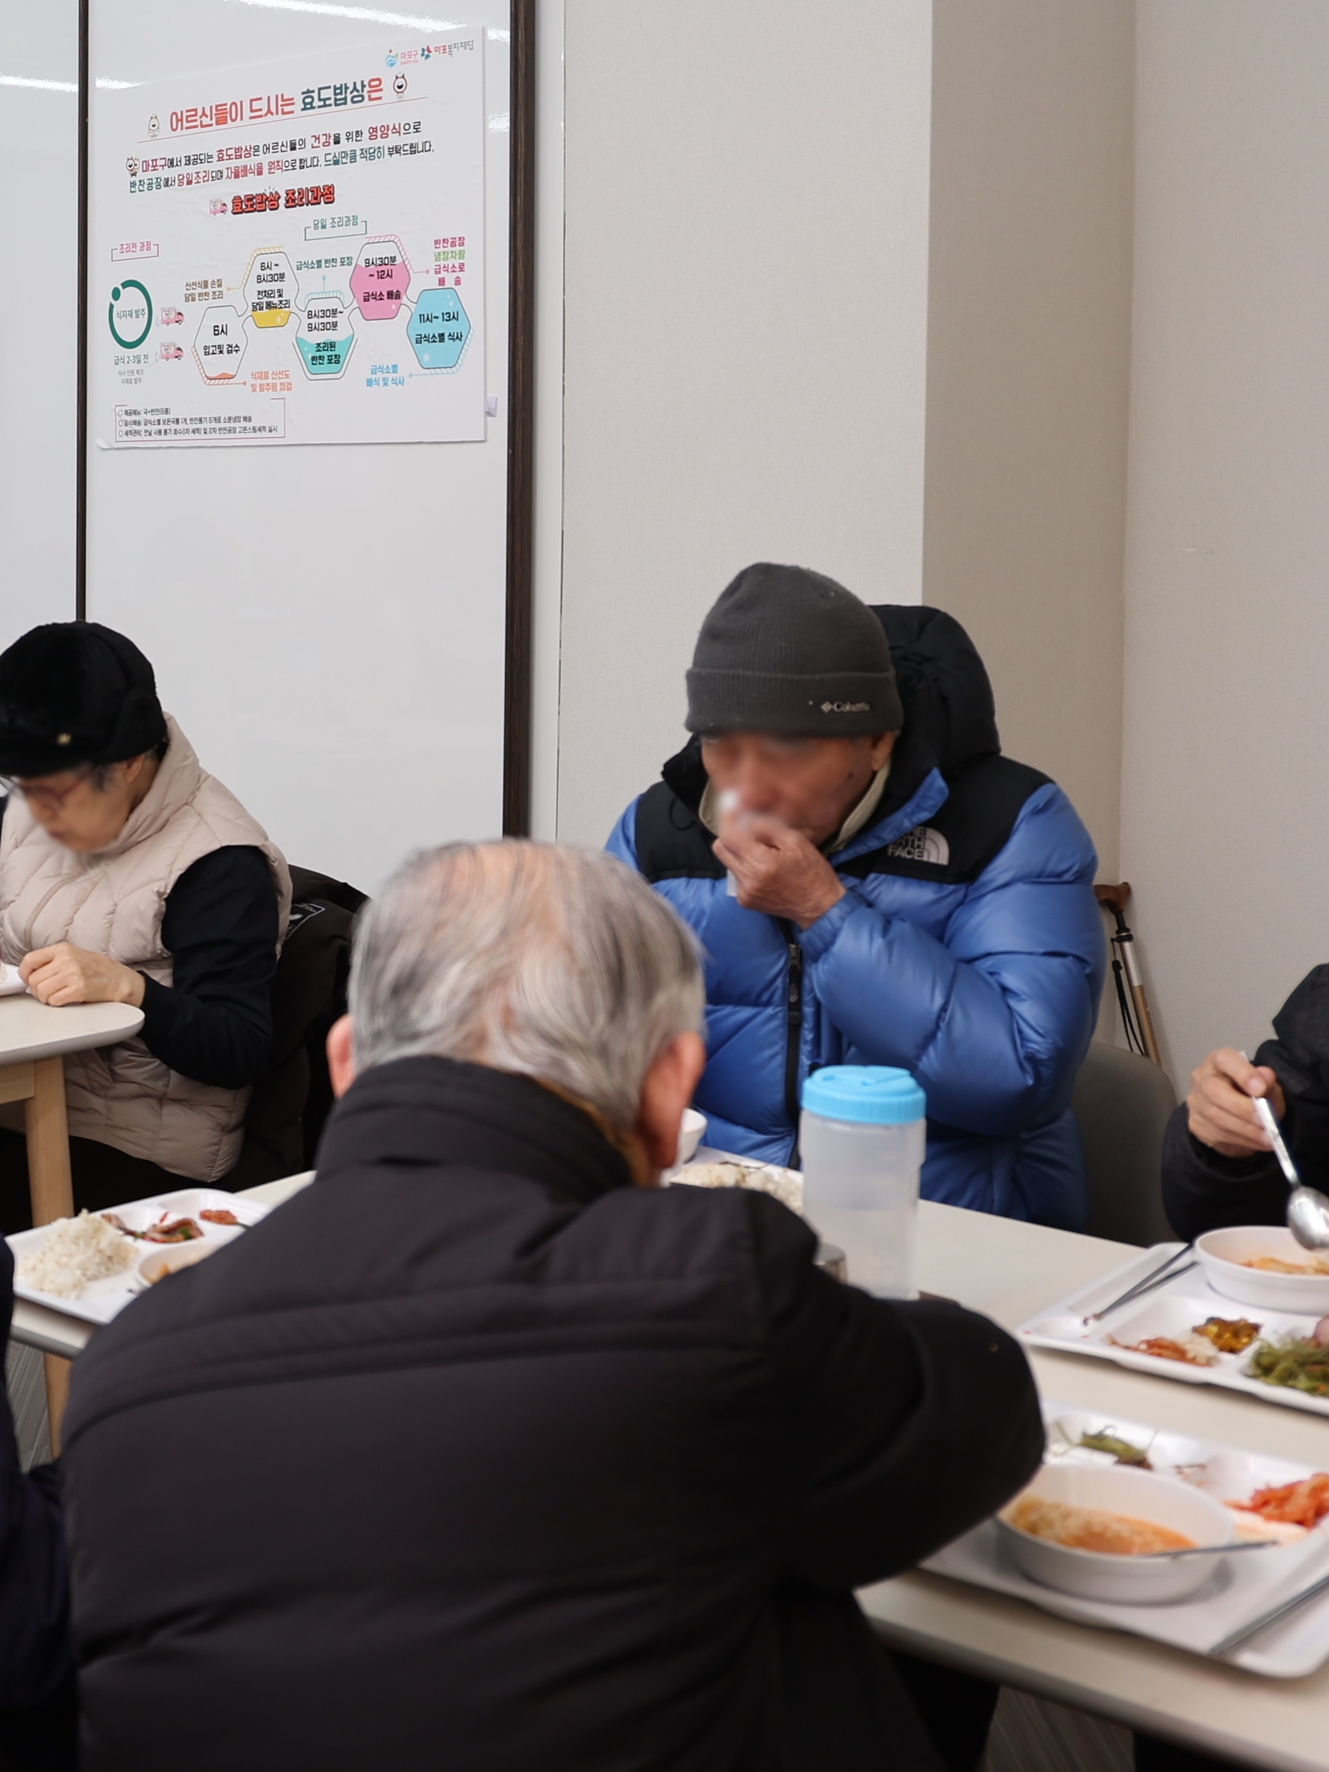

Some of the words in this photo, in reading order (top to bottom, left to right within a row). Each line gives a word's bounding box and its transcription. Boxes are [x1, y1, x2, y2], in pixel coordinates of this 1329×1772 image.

[170, 100, 244, 132] 어르신들이
[248, 93, 296, 120] 드시는
[301, 77, 384, 112] 효도밥상은
[142, 155, 182, 173] 마포구에서
[183, 152, 214, 166] 제공되는
[216, 144, 261, 162] 효도밥상은
[262, 138, 306, 156] 어르신들의
[311, 133, 341, 149] 건강을
[345, 129, 363, 142] 위한
[368, 121, 422, 140] 영양식으로
[225, 162, 264, 180] 자율배식을
[267, 158, 297, 175] 원칙으로
[299, 156, 322, 170] 합니다.
[324, 149, 357, 166] 드실만큼
[359, 145, 385, 161] 적당히
[387, 140, 434, 157] 부탁드립니다.
[231, 190, 281, 215] 효도밥상
[284, 183, 336, 209] 조리과정
[313, 218, 327, 230] 당일
[329, 214, 359, 228] 조리과정
[119, 243, 137, 254] 조리전
[139, 241, 152, 252] 과정
[434, 237, 465, 249] 반찬공장
[364, 255, 397, 267] 9시30분
[434, 250, 465, 262] 냉장차량
[260, 261, 272, 271] 6시
[296, 260, 322, 271] 급식소별
[324, 258, 338, 267] 반찬
[339, 256, 353, 267] 포장
[434, 263, 465, 274] 급식소로
[256, 272, 285, 284] 8시30분
[376, 269, 393, 280] 12시
[185, 280, 209, 291] 신선식품
[210, 278, 223, 288] 손질
[184, 292, 196, 303] 당일
[197, 291, 210, 301] 반찬
[211, 290, 223, 300] 조리
[256, 289, 276, 300] 전처리
[276, 288, 284, 298] 및
[363, 291, 385, 302] 급식소
[386, 290, 401, 300] 배송
[251, 302, 264, 311] 당일
[265, 299, 291, 310] 메뉴조리
[116, 309, 133, 320] 식자재
[134, 308, 146, 319] 발주
[307, 308, 344, 319] 8시30분~
[441, 311, 459, 322] 13시
[213, 324, 228, 336] 6시
[307, 321, 338, 332] 9시30분
[415, 332, 445, 344] 급식소별
[447, 331, 463, 342] 식사
[203, 344, 224, 356] 입고및
[225, 343, 240, 355] 검수
[315, 342, 336, 352] 조리된
[114, 355, 125, 366] 급식
[126, 354, 142, 365] 2-3일
[142, 354, 149, 364] 전
[311, 355, 325, 365] 반찬
[327, 354, 341, 364] 포장
[271, 370, 291, 380] 신선도
[371, 364, 398, 375] 급식소별
[250, 383, 257, 392] 및
[366, 378, 380, 387] 배식
[382, 377, 389, 386] 및
[390, 376, 405, 386] 식사
[887, 845, 925, 861] FACE
